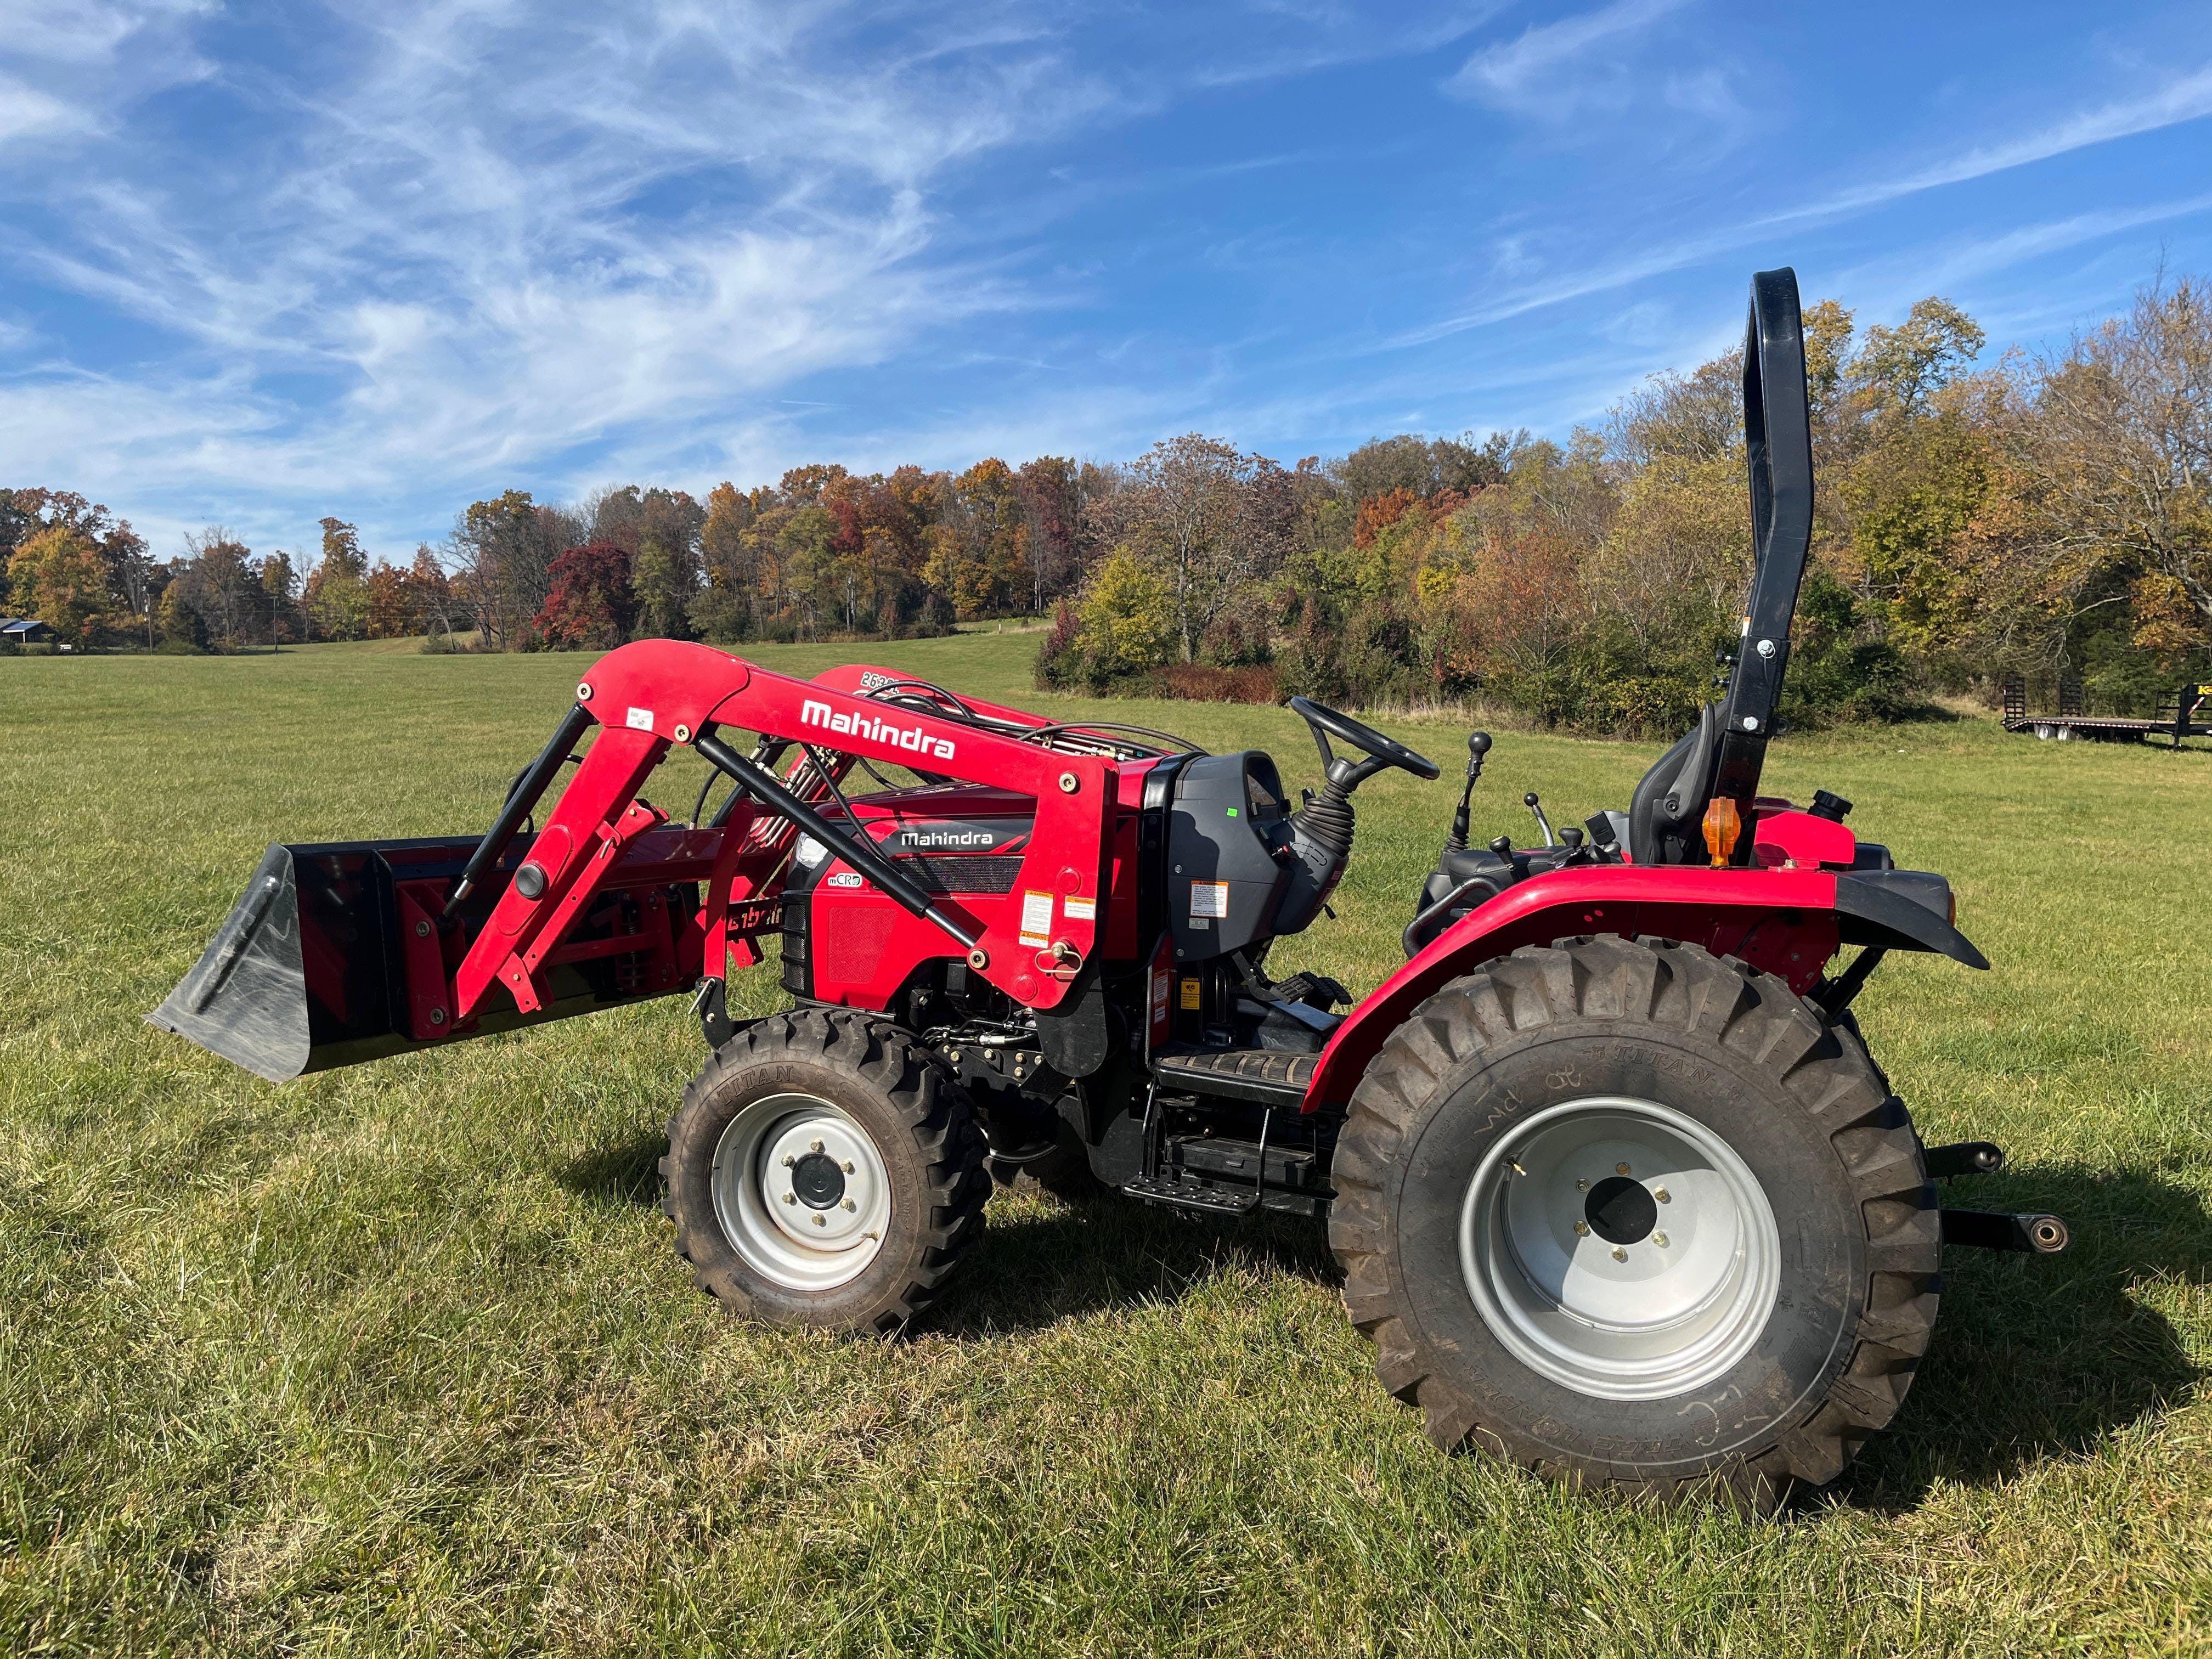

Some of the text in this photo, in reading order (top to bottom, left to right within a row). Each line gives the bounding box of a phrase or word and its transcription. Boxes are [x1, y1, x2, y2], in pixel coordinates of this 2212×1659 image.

[800, 699, 955, 760] Mahindra
[901, 831, 992, 846] Mahindra
[1614, 1045, 1715, 1085] TITAN
[716, 1065, 794, 1107] TITAN
[1593, 1435, 1684, 1454] TRAC
